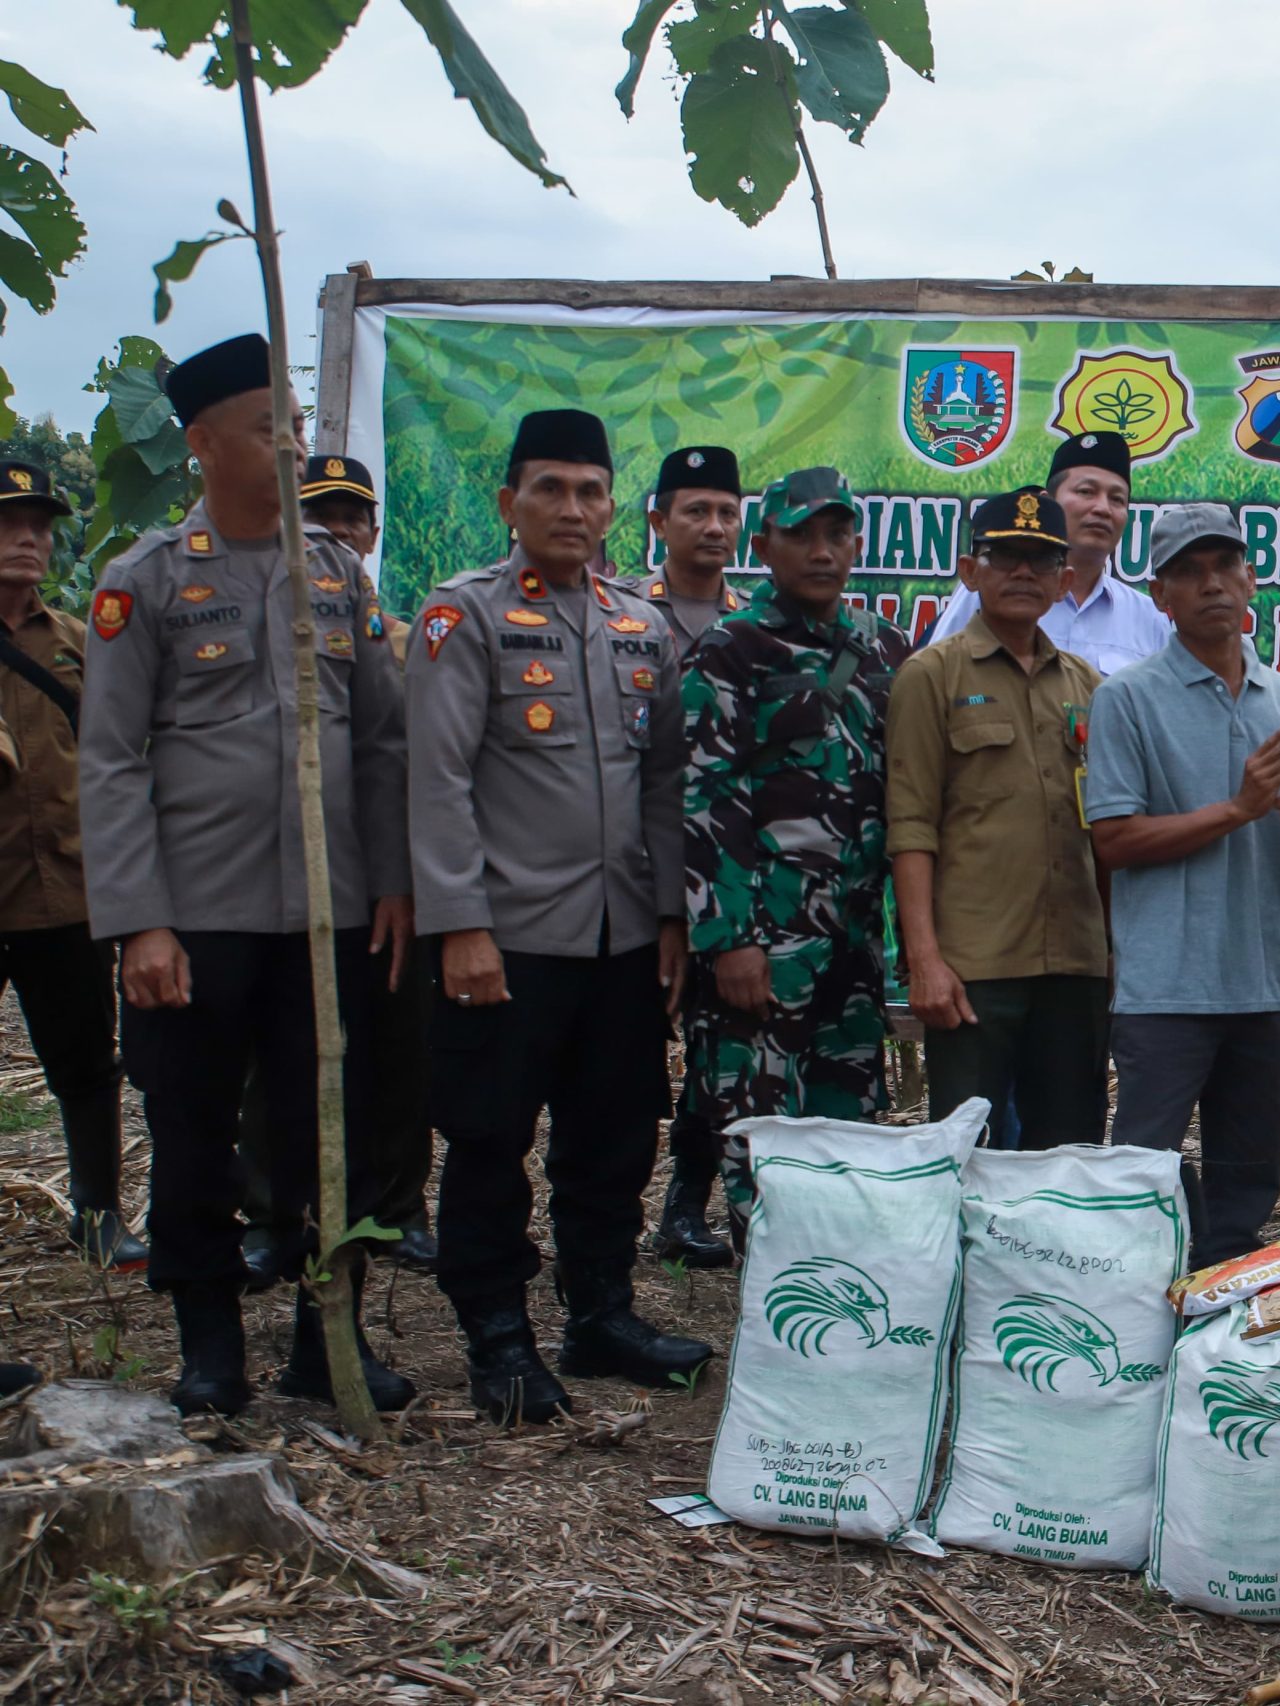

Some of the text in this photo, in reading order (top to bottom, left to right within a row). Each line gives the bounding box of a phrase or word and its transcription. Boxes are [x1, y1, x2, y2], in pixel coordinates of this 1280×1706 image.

[165, 605, 242, 631] SULIANTO
[611, 639, 660, 658] POLRI
[775, 1471, 821, 1487] Diproduksi
[753, 1484, 868, 1511] CV. LANG BUANA
[777, 1513, 840, 1529] JAWA TIMUR
[1015, 1502, 1063, 1522] Diproduksi
[1064, 1512, 1086, 1525] Oleh
[993, 1511, 1109, 1546] CV. LANG BUANA
[1013, 1543, 1076, 1561] JAWA TIMUR
[1228, 1570, 1279, 1584] Diproduksi
[1207, 1580, 1229, 1599] CV.
[1235, 1587, 1277, 1602] LANG
[1238, 1607, 1267, 1617] JAWA
